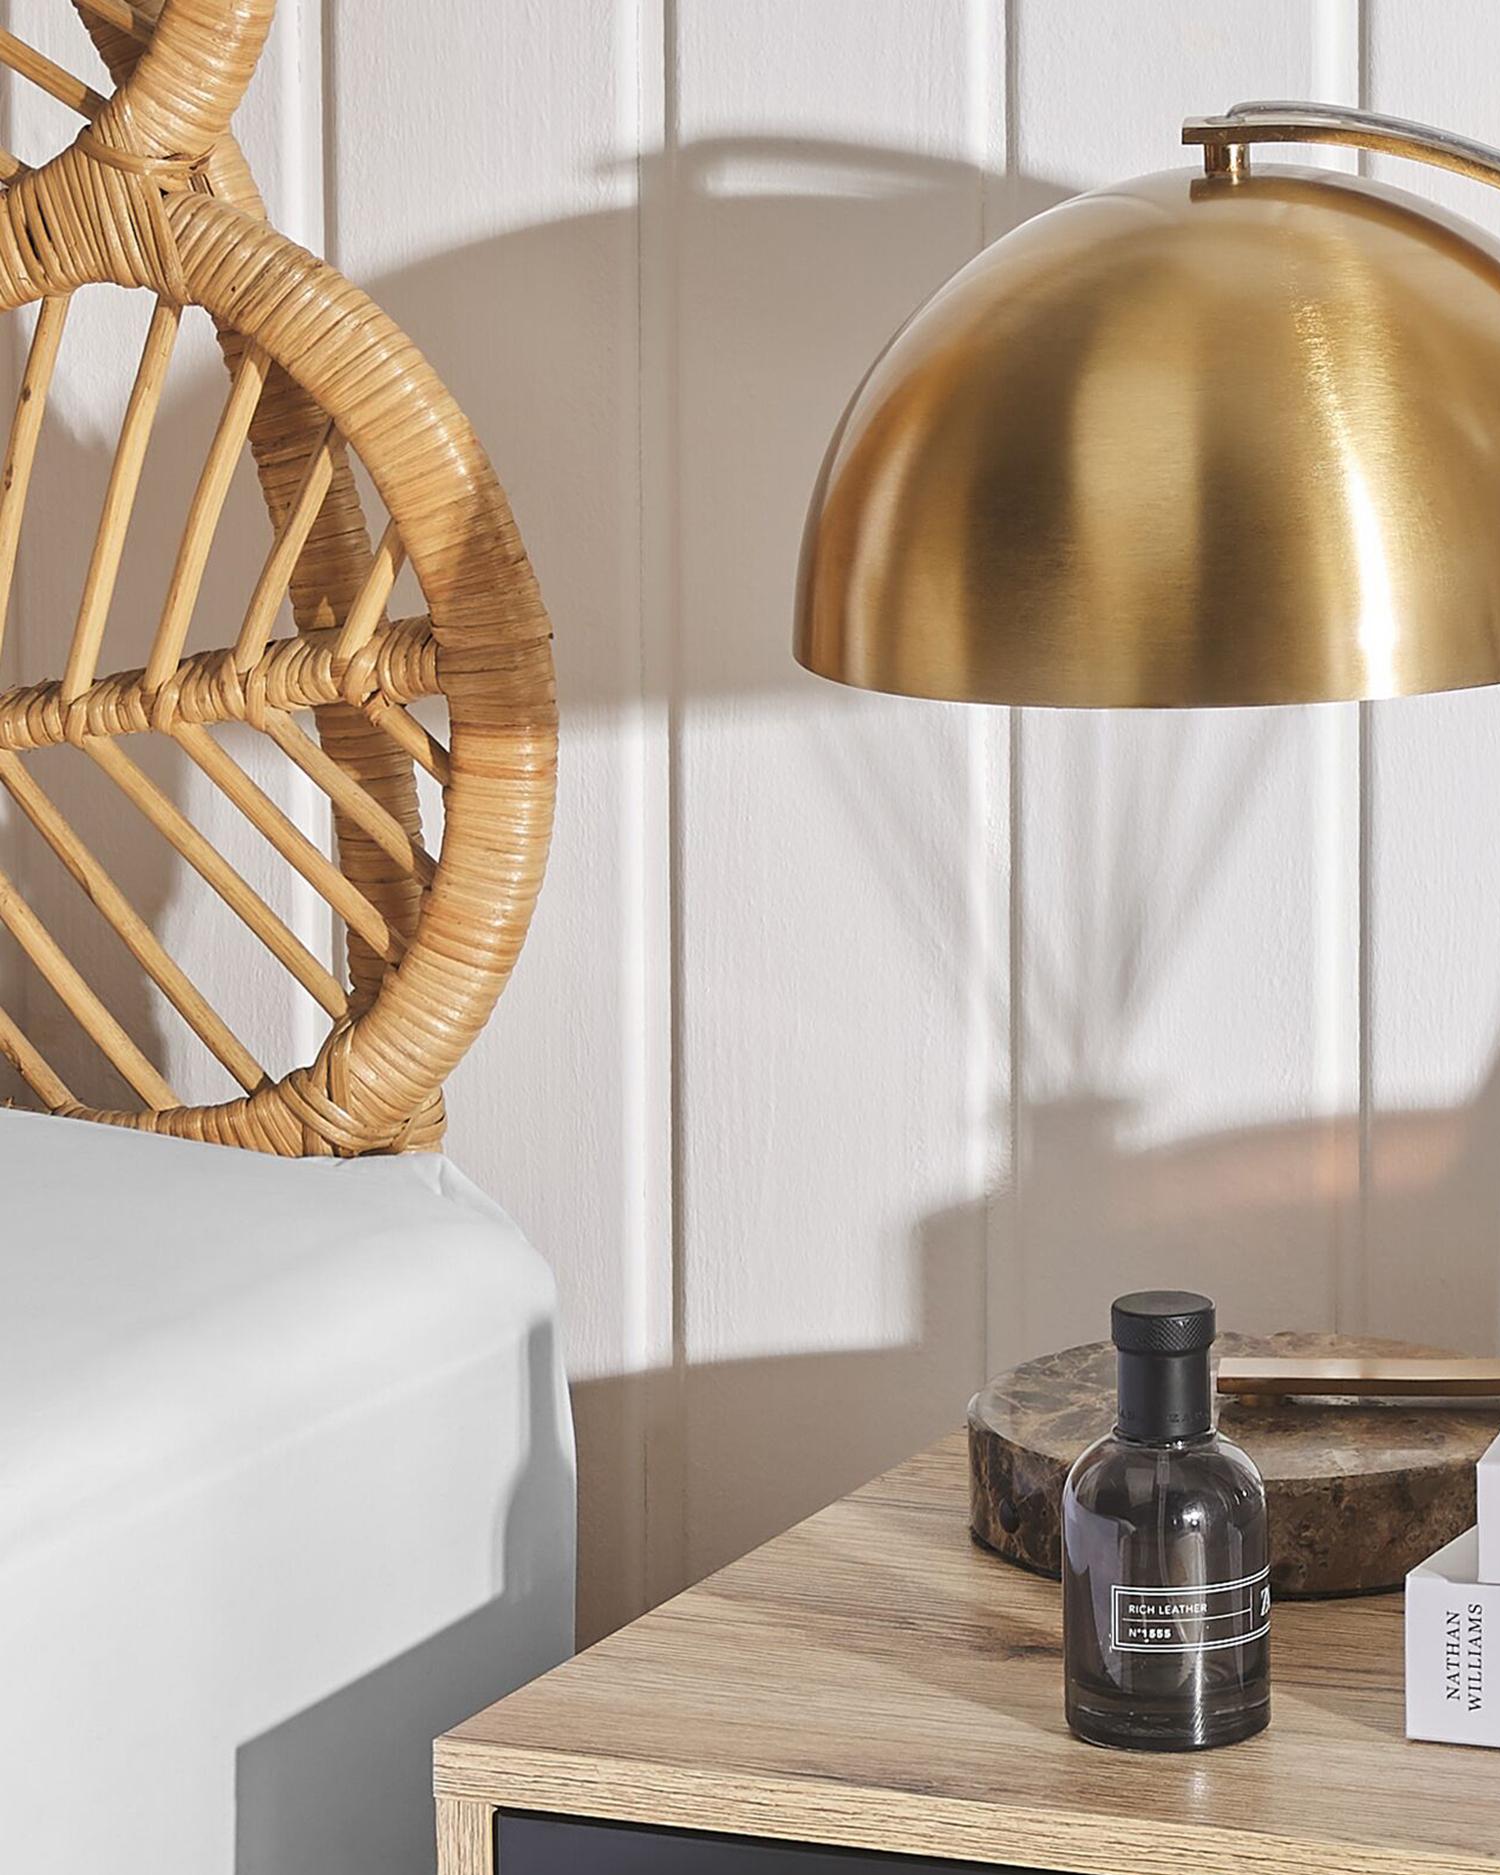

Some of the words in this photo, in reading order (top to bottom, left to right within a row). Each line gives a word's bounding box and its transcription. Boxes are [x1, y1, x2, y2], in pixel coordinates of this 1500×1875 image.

[1128, 1603, 1155, 1615] RICH
[1158, 1603, 1208, 1616] LEATHER
[1446, 1611, 1461, 1700] NATHAN
[1468, 1603, 1483, 1711] WILLIAMS
